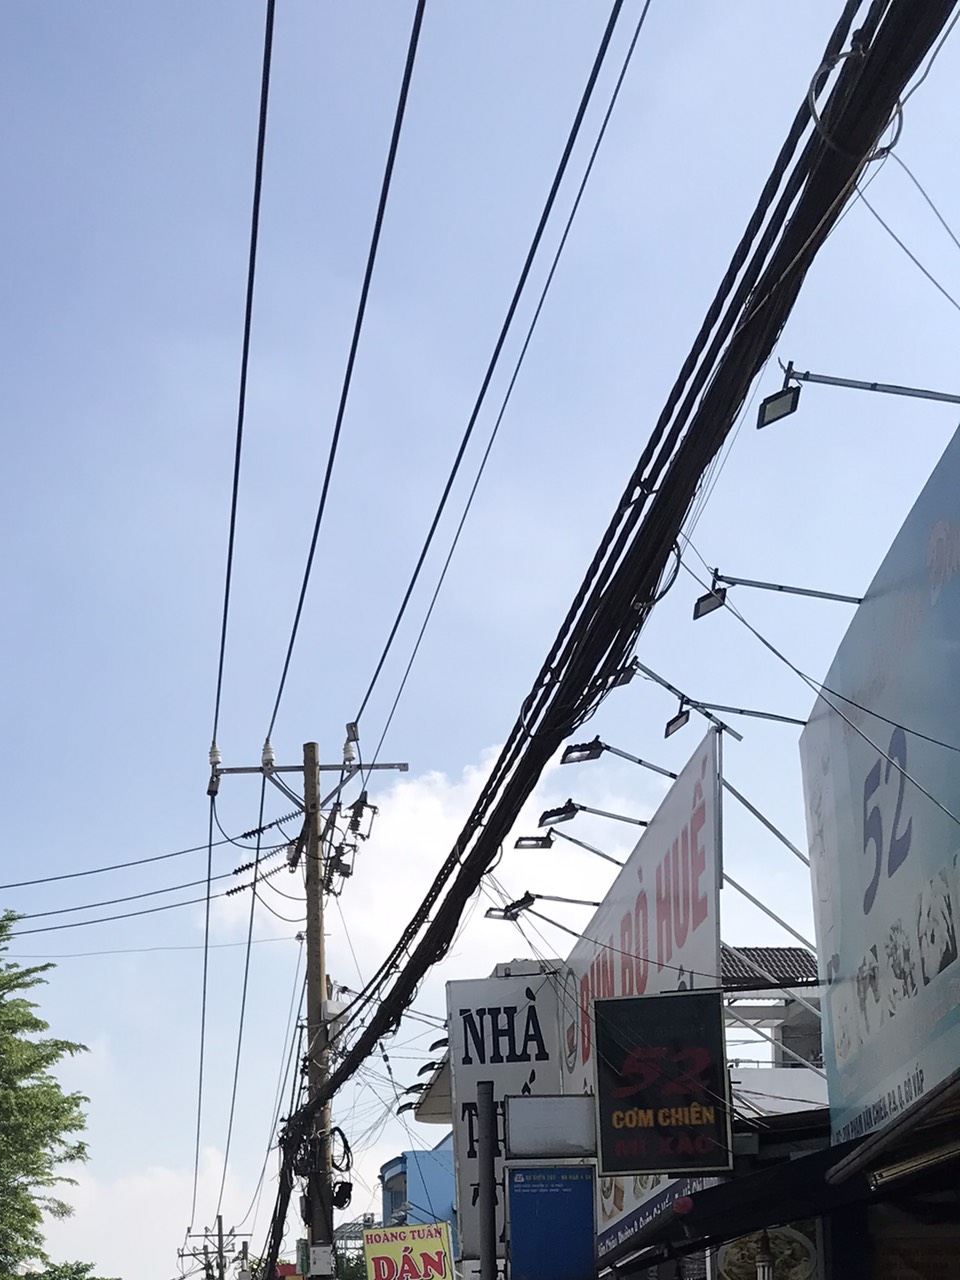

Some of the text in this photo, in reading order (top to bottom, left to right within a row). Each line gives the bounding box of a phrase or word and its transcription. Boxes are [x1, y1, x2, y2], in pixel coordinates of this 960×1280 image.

[862, 726, 912, 915] 52
[620, 865, 648, 999] BÒ
[656, 754, 708, 974] HUẾ
[459, 987, 549, 1065] NHÀ
[610, 1046, 711, 1098] 52
[612, 1102, 716, 1129] CƠM CHIÊN
[365, 1230, 406, 1244] HOÀNG
